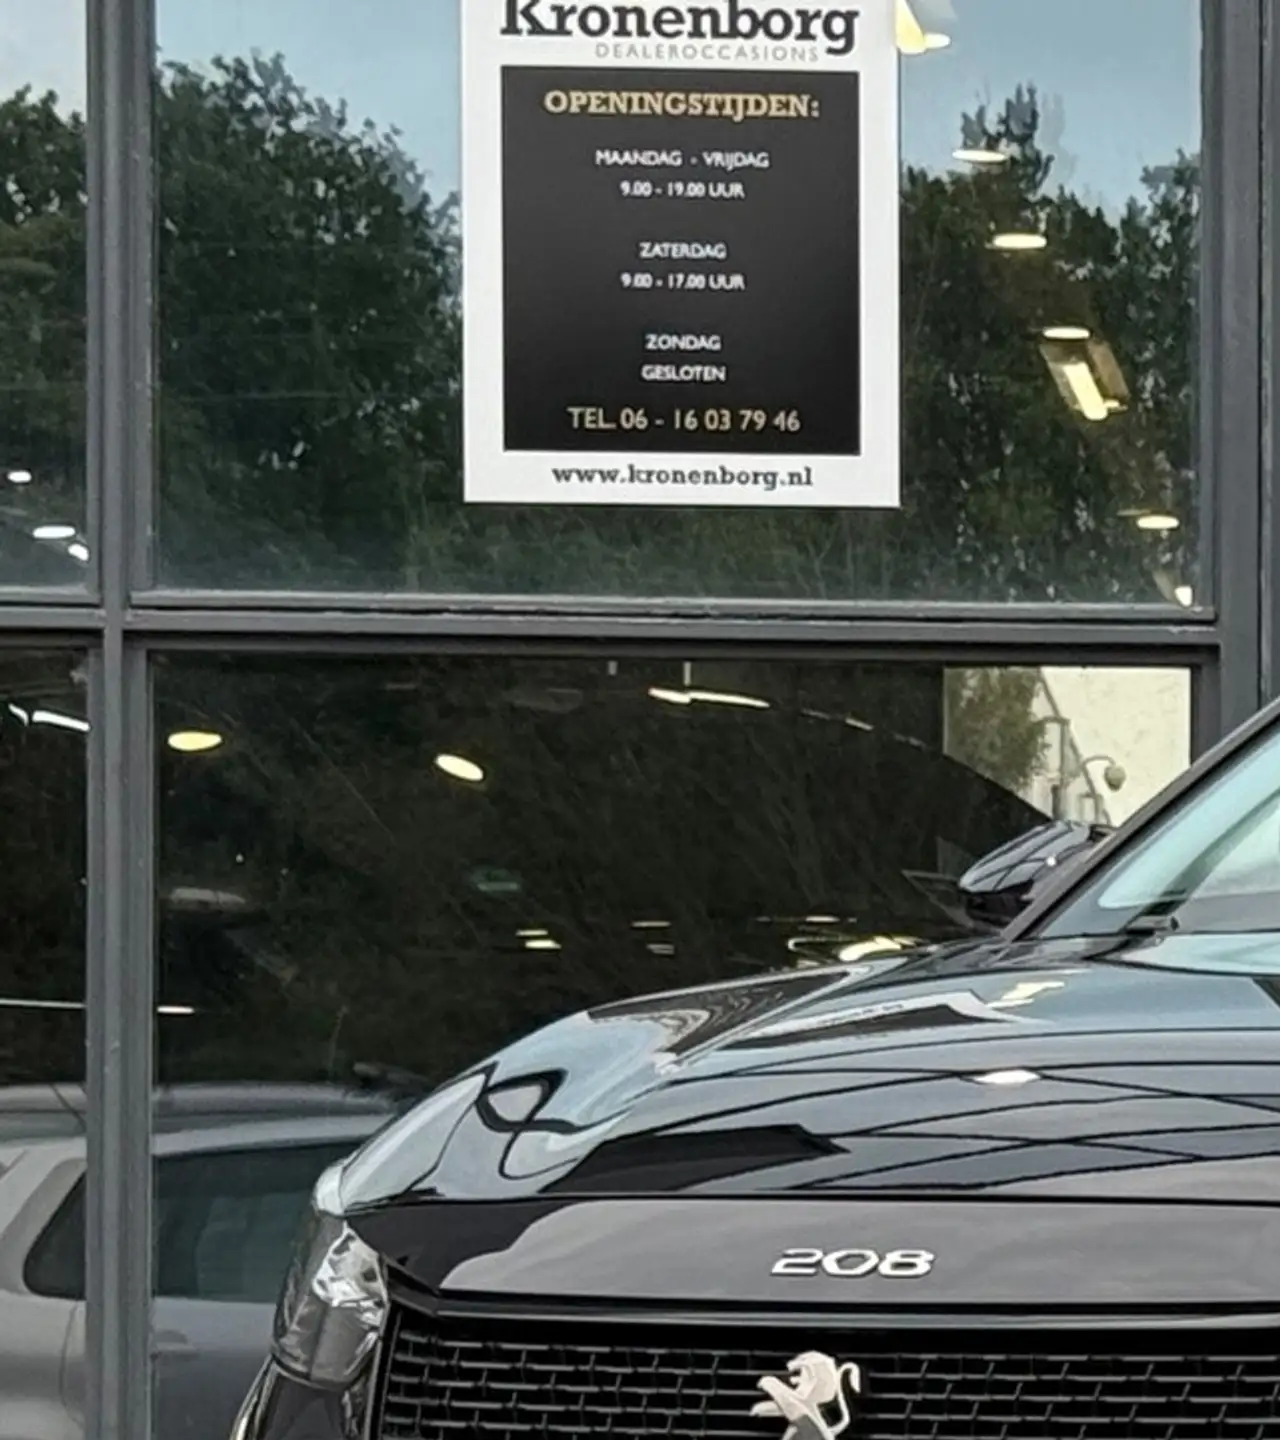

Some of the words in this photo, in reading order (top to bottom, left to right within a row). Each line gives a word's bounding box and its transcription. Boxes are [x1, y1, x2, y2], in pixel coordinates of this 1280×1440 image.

[500, 0, 860, 55] Kronenborg
[595, 42, 819, 62] DEALEROCCASIONS
[544, 90, 820, 123] OPENINGSTIJDEN:
[595, 150, 683, 167] MAANDAG
[703, 151, 770, 170] VRIJDAG
[620, 181, 652, 197] 9.00
[667, 181, 706, 198] 19.00
[708, 182, 745, 198] UUR
[639, 242, 727, 259] ZATERDAG
[708, 273, 745, 290] UUR
[645, 333, 722, 351] ZONDAG
[640, 363, 727, 382] GESLOTEN
[620, 407, 648, 430] 06
[673, 408, 698, 431] 16
[703, 409, 731, 431] 03
[740, 409, 767, 431] 79
[773, 410, 801, 432] 46
[551, 463, 813, 491] www.kronenborg.nl
[771, 1247, 935, 1277] 208
